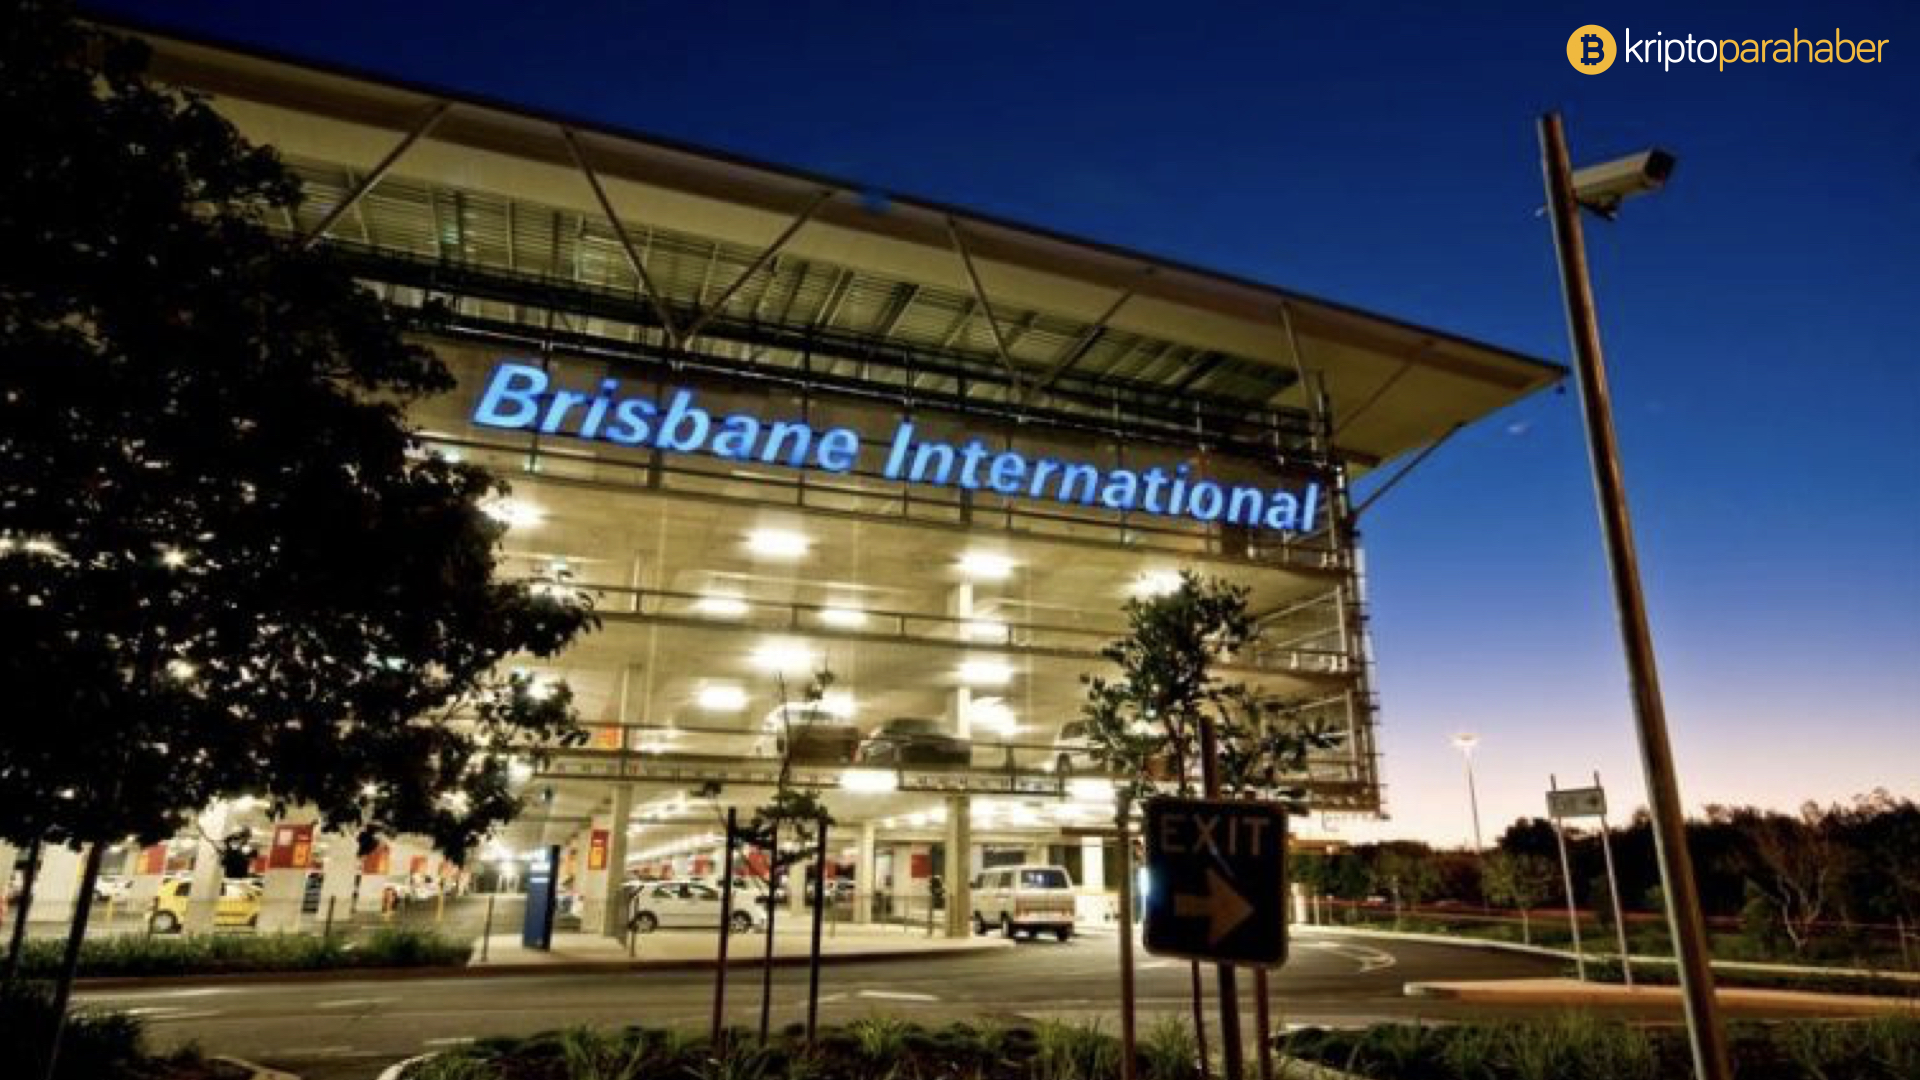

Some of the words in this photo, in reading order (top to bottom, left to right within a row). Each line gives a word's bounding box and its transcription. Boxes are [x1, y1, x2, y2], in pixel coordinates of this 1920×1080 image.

[472, 362, 860, 472] Brisbane
[883, 420, 1319, 531] International
[1160, 813, 1269, 855] EXIT
